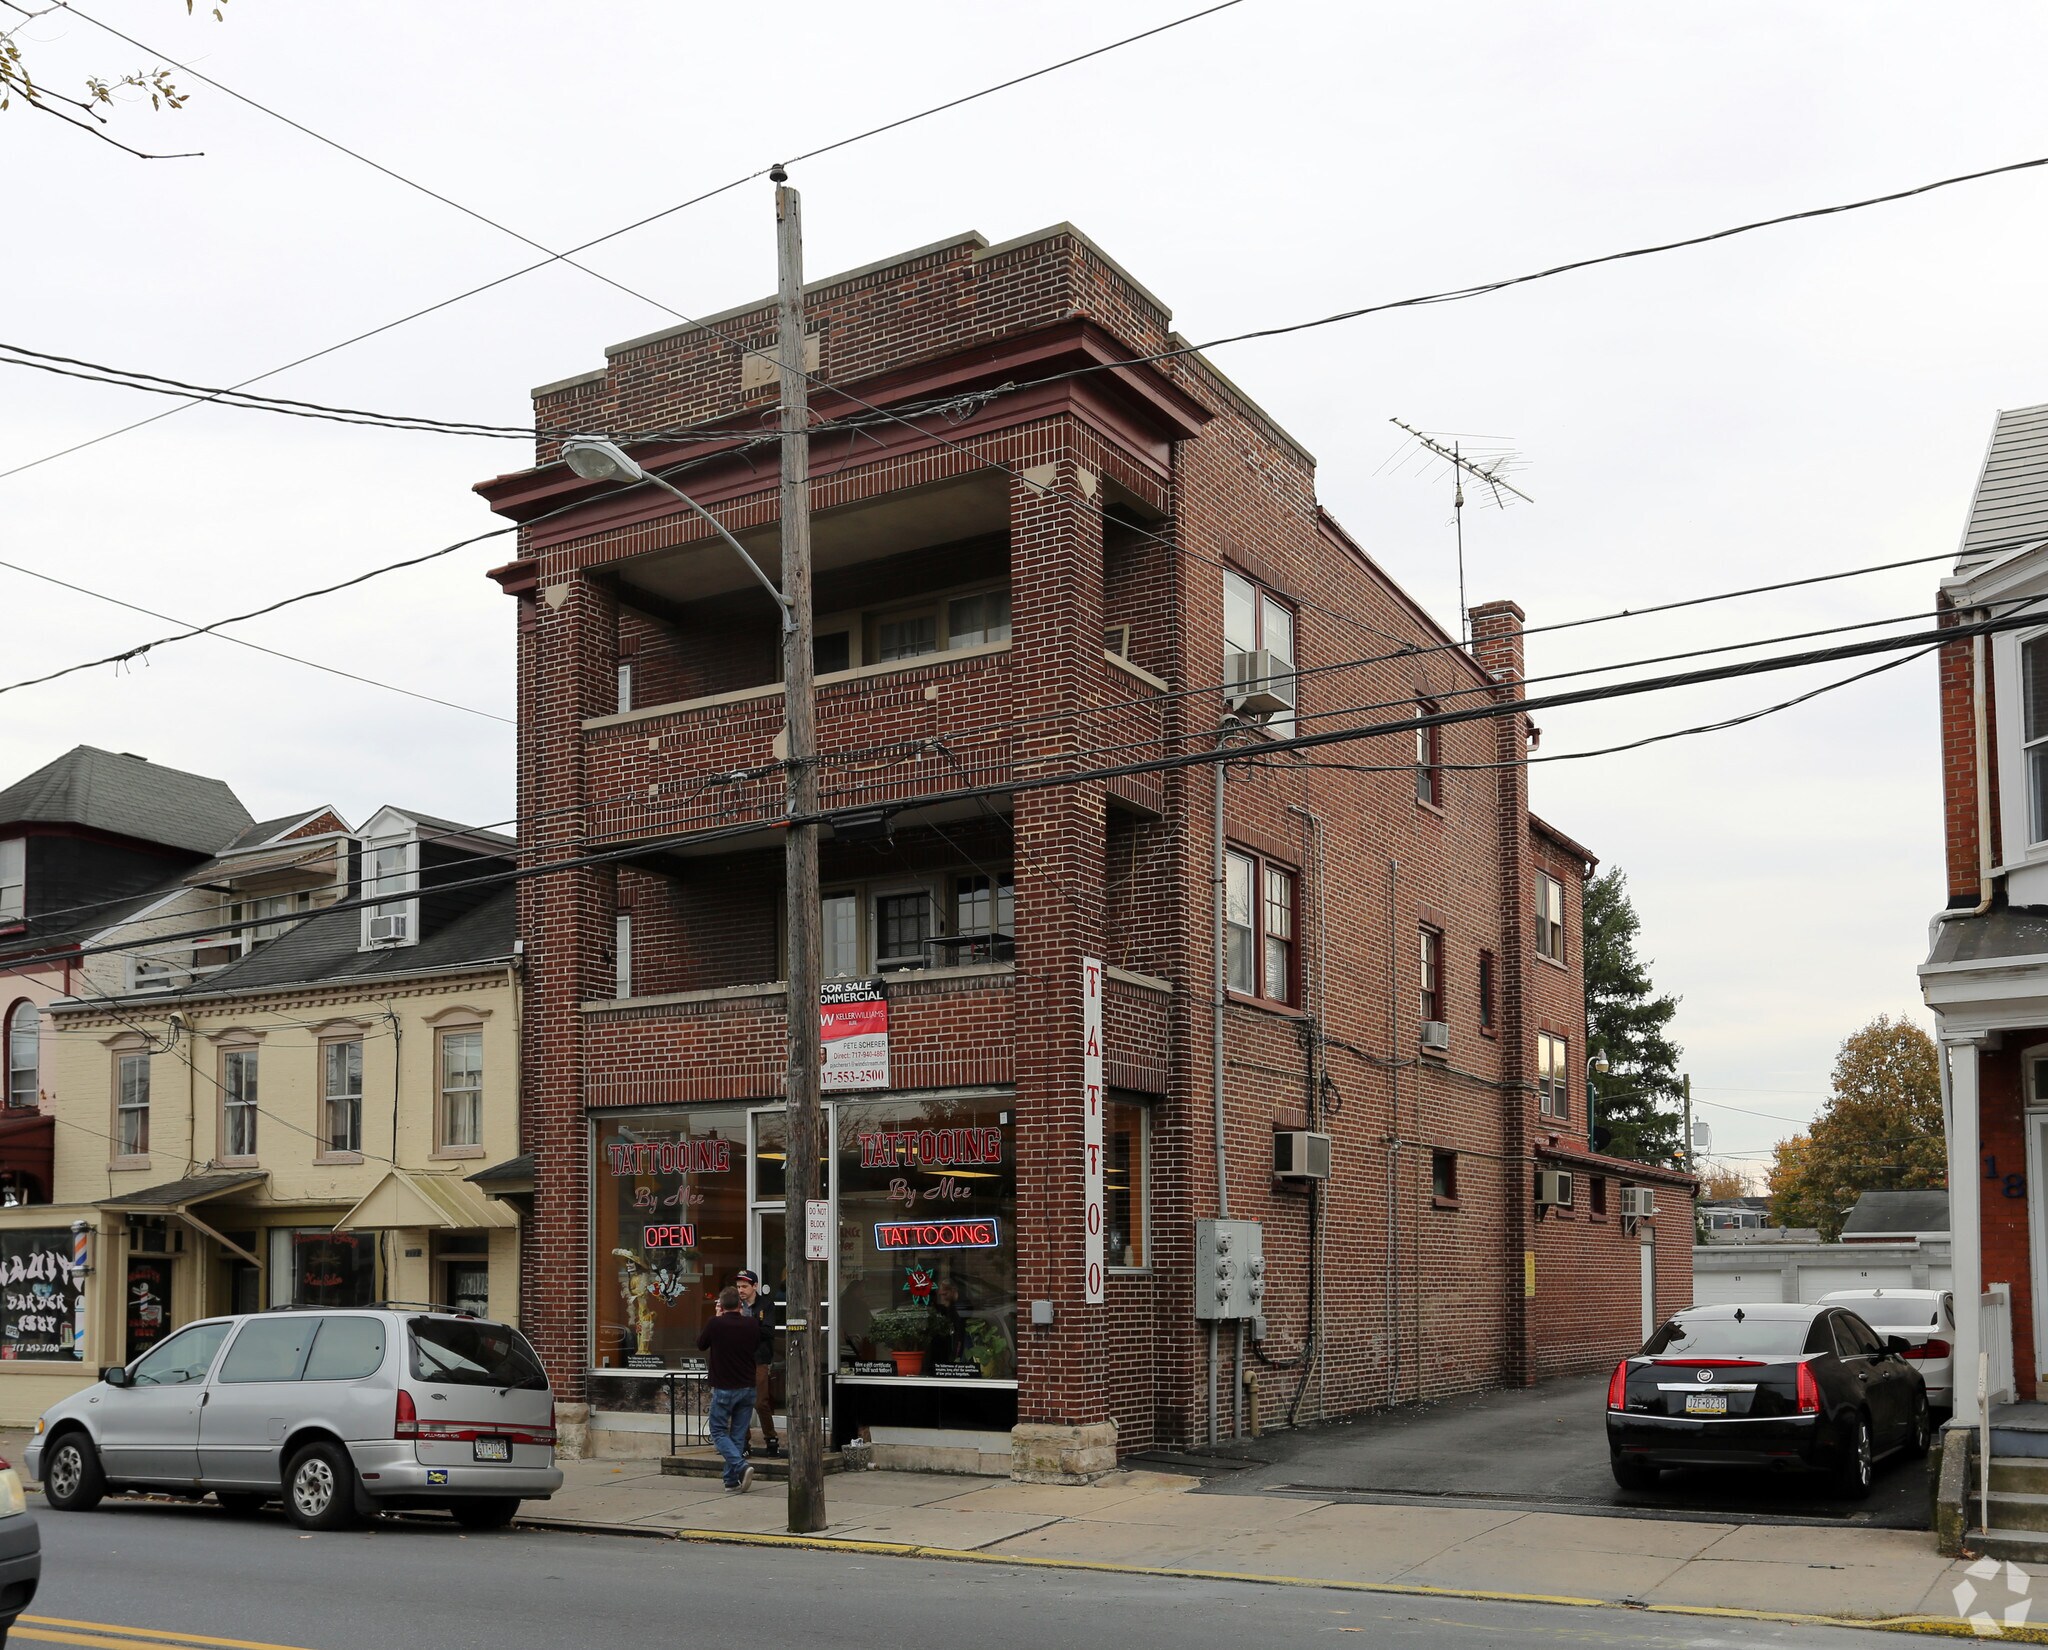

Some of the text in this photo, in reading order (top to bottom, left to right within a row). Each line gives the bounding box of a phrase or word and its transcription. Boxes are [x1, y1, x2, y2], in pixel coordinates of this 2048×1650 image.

[820, 990, 883, 1004] OMMERCIAL
[821, 981, 872, 994] FOR SALE
[859, 1040, 886, 1049] SCHERER
[822, 1069, 884, 1084] 17-553-2500
[1085, 965, 1100, 1295] TATTOO
[607, 1139, 731, 1177] TATTOOING
[857, 1126, 1003, 1169] TATTOOING
[632, 1185, 658, 1214] By
[887, 1176, 972, 1208] By Mee
[809, 1207, 827, 1216] DO NOT
[810, 1220, 826, 1228] BLOCK
[879, 1224, 991, 1246] TATTOOING
[645, 1225, 693, 1248] OPEN
